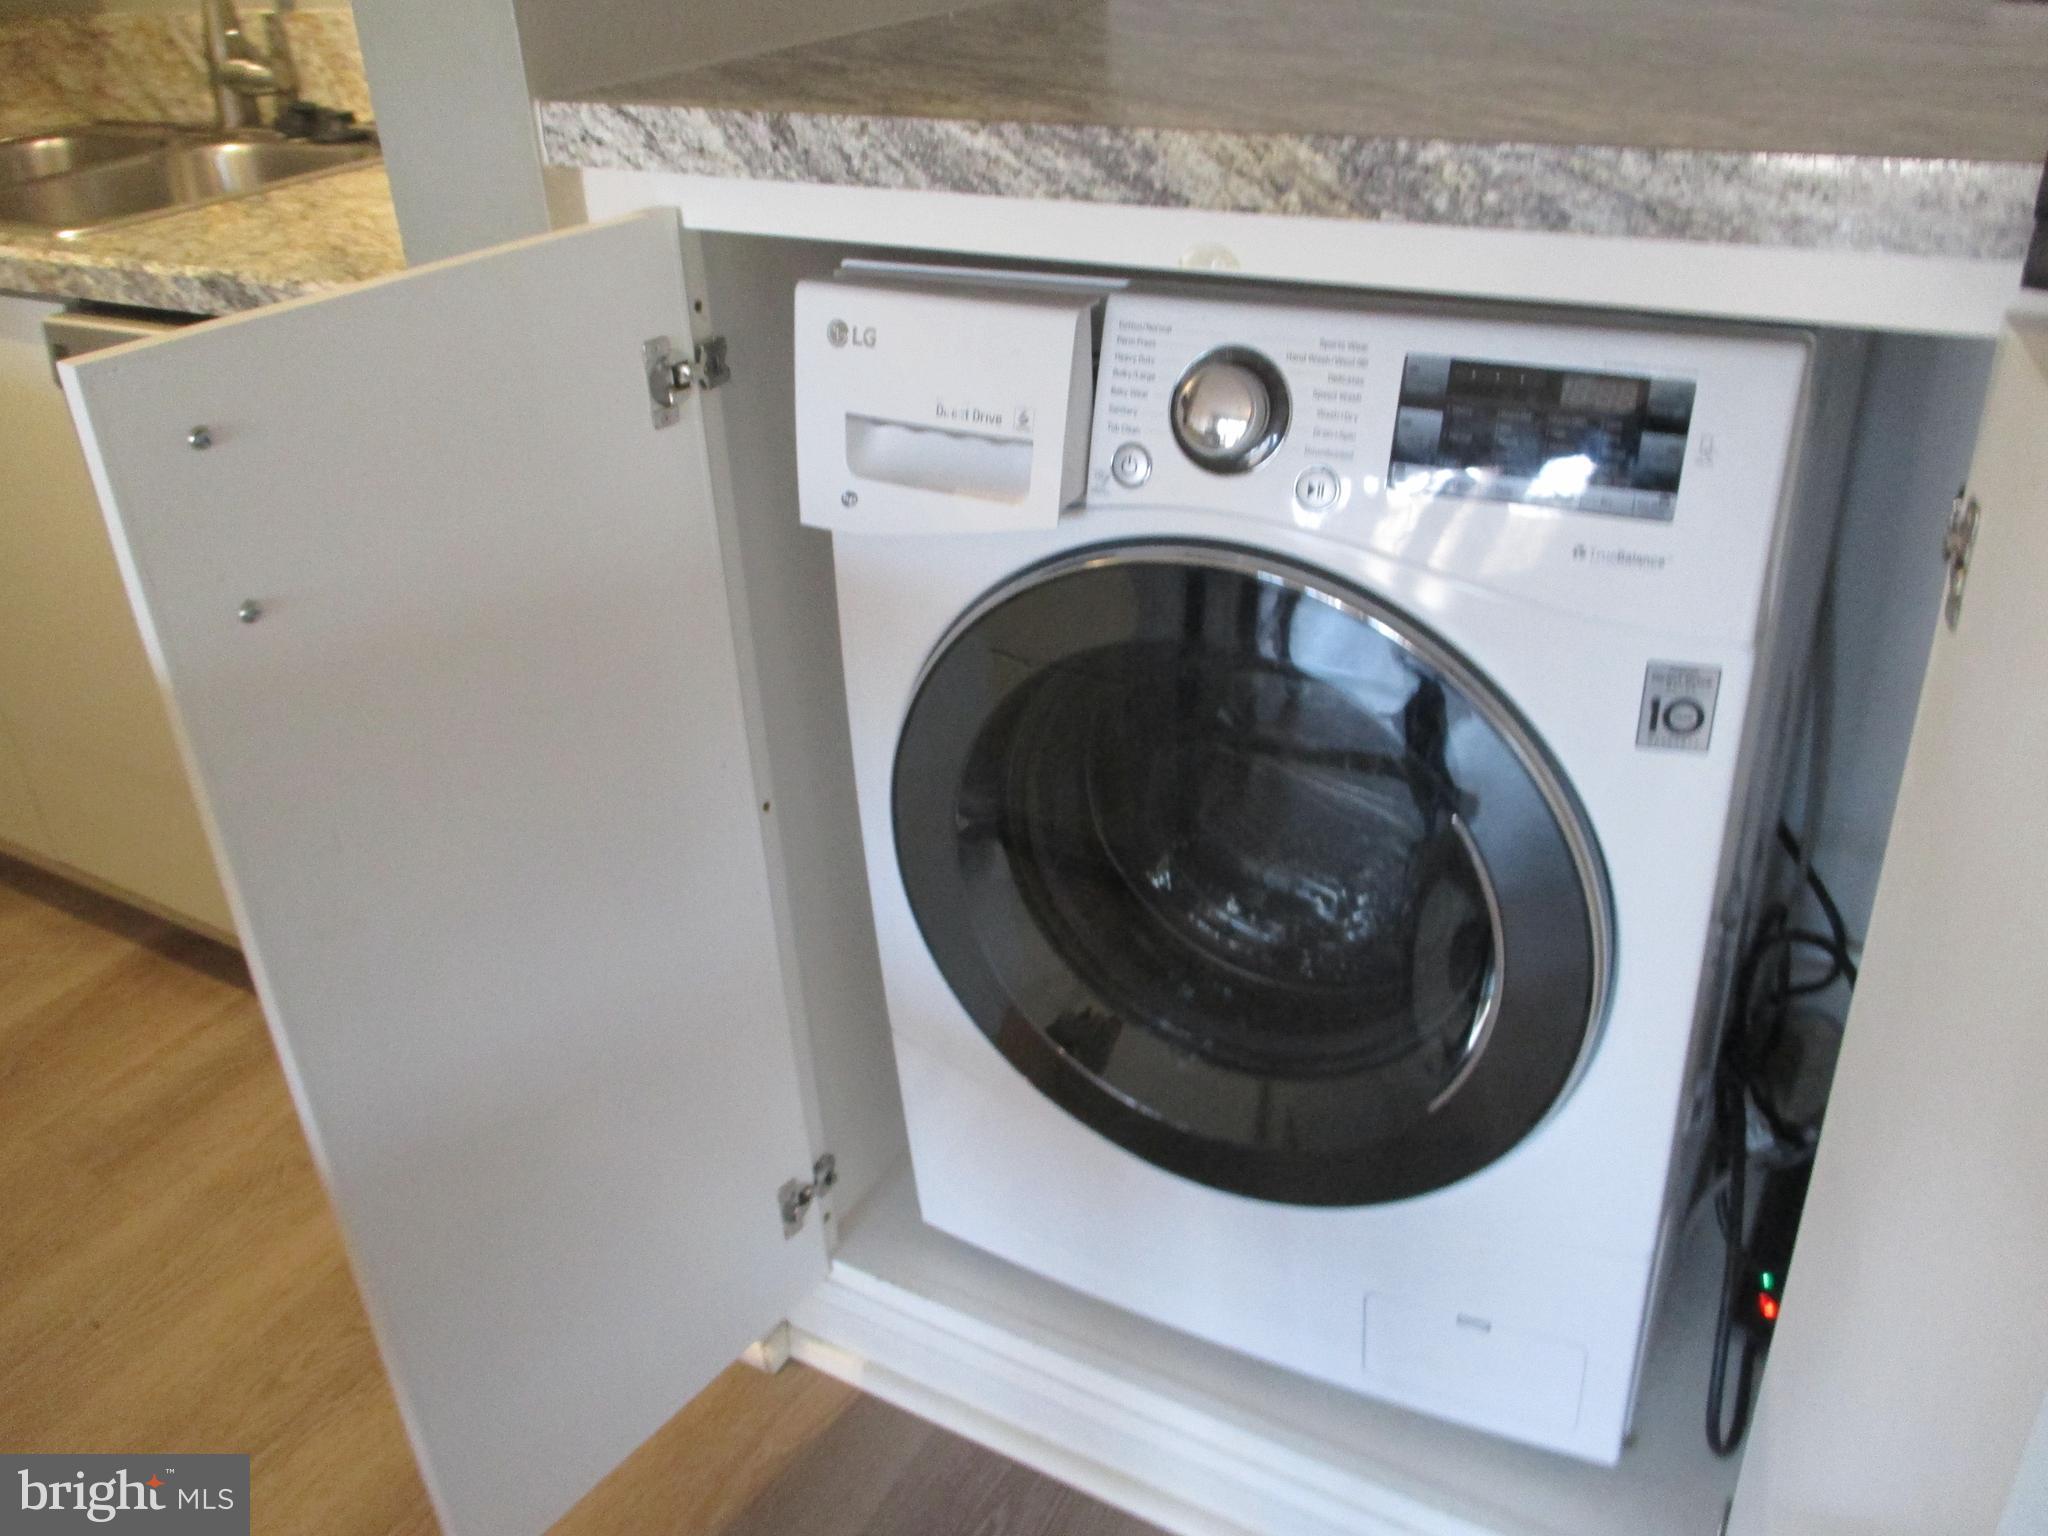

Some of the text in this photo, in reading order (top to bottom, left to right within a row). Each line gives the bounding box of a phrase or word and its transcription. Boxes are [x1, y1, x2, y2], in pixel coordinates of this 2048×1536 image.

[851, 325, 877, 348] LG
[936, 403, 1002, 425] Diect Drive
